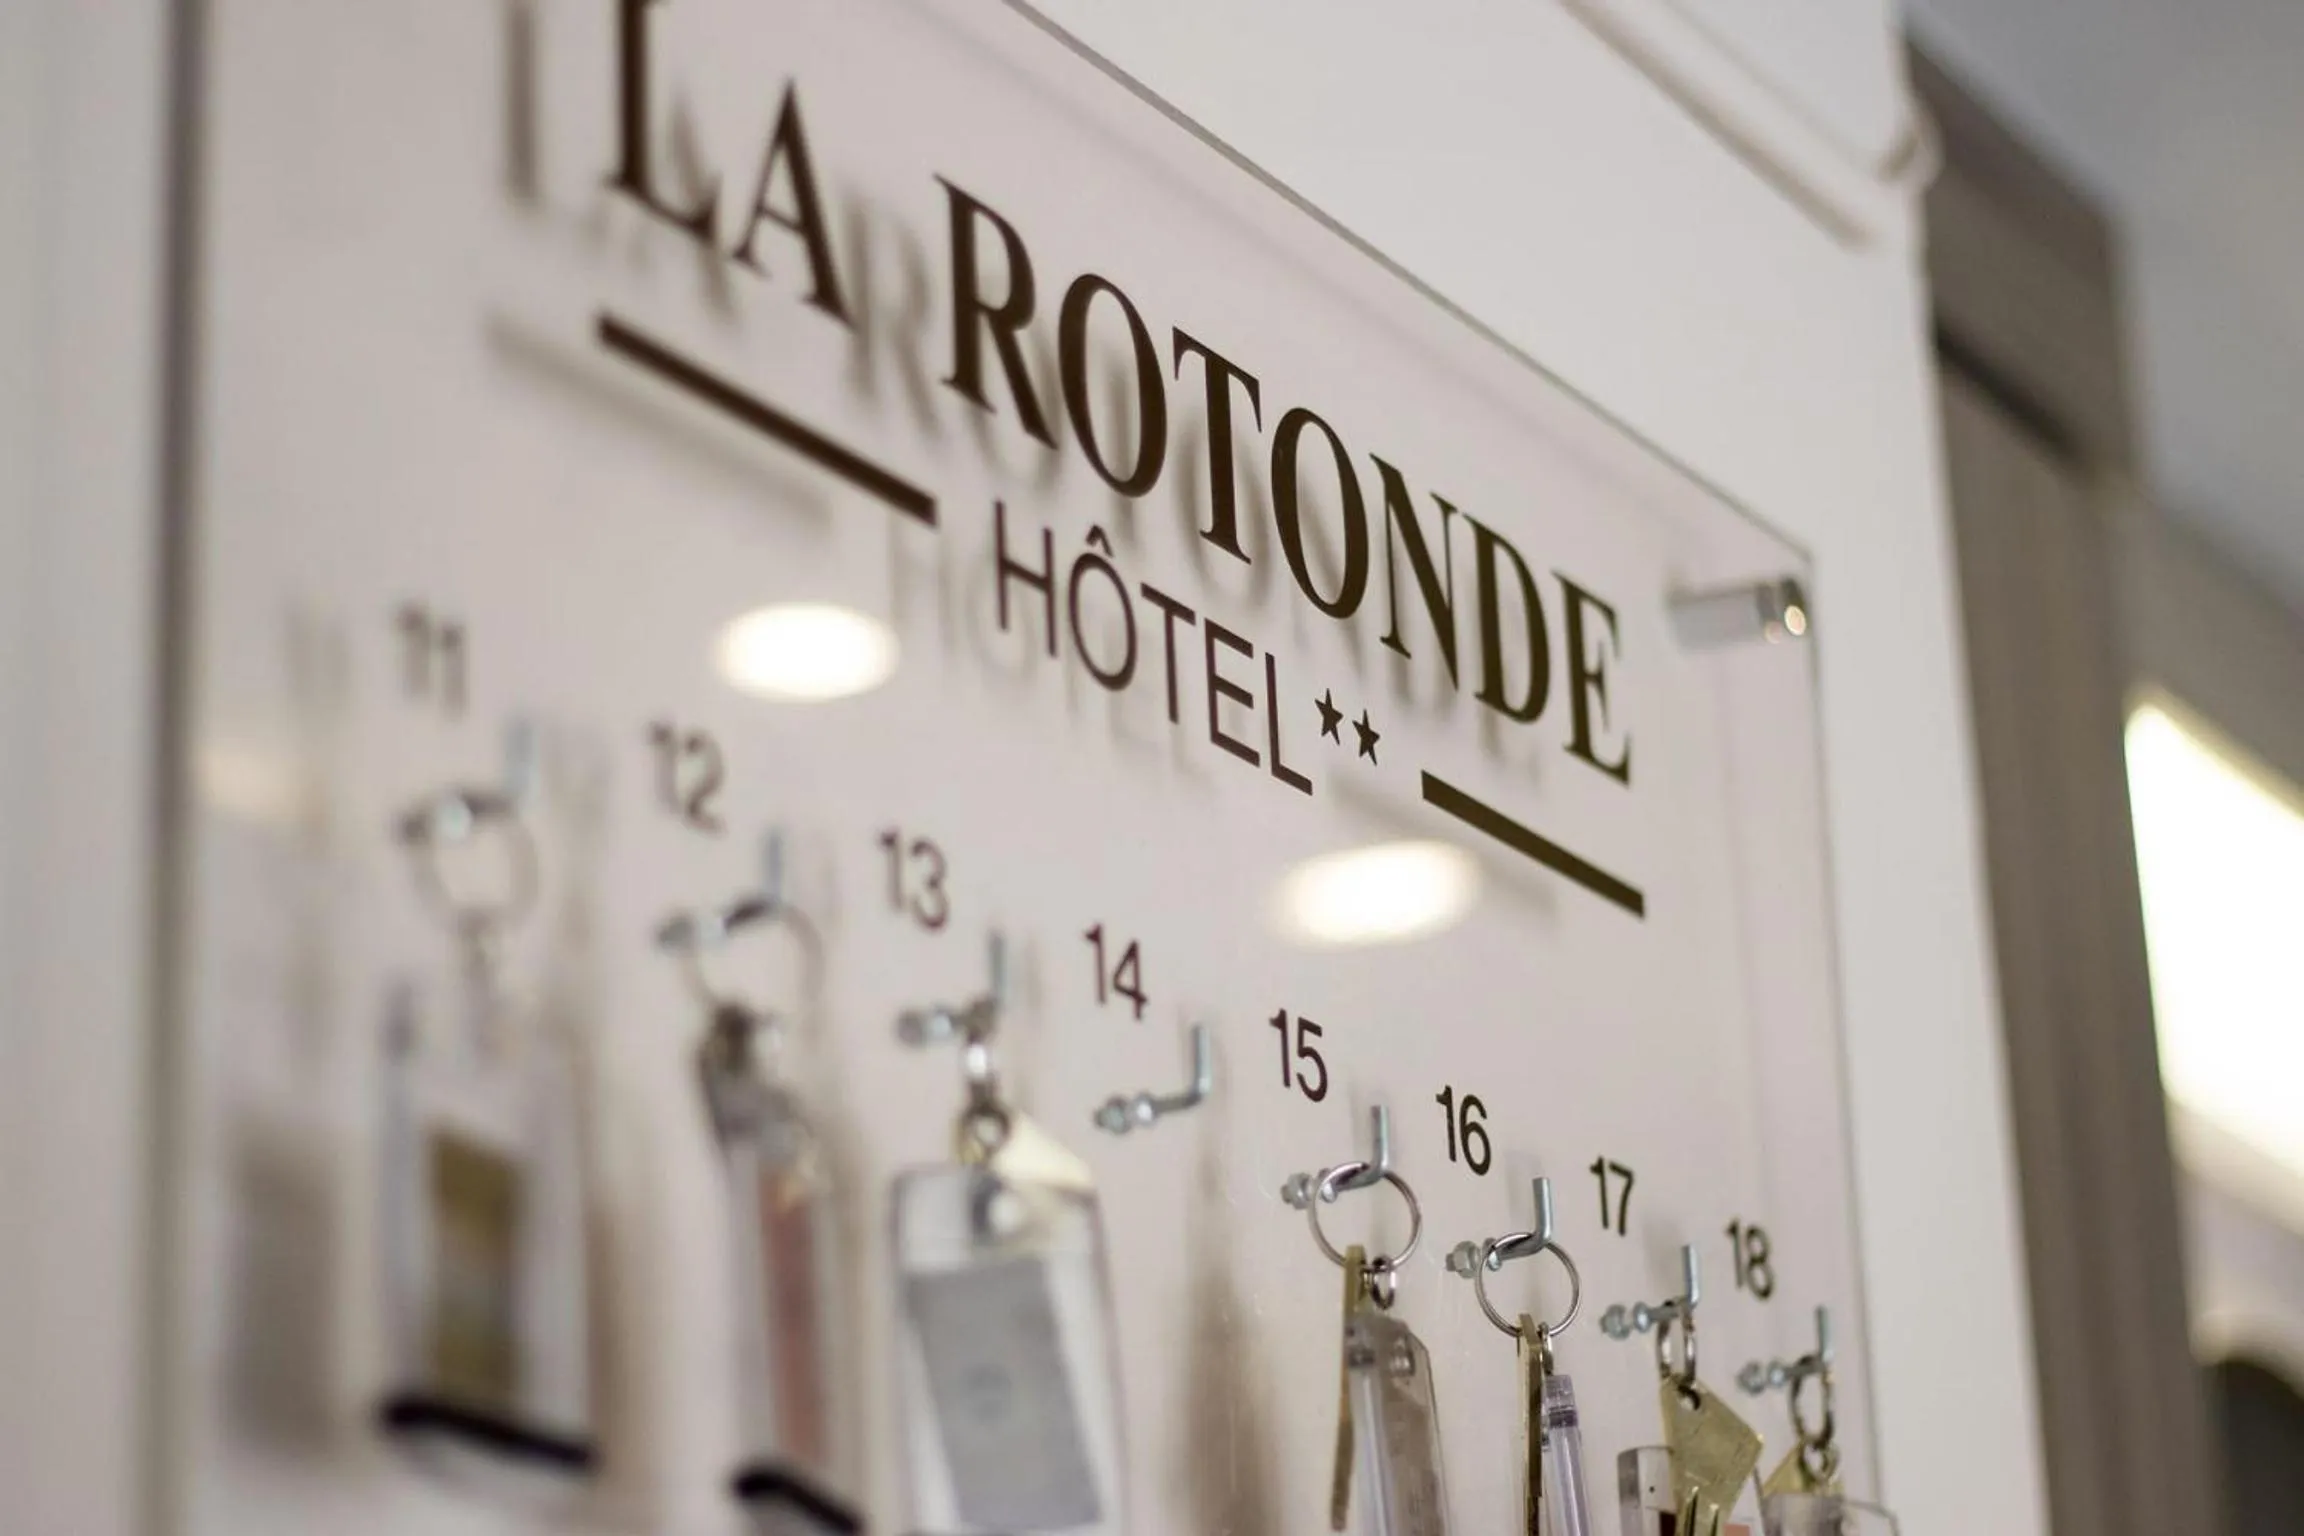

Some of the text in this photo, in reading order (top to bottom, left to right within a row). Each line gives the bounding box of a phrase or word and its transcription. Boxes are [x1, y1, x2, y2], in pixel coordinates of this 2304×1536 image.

[602, 0, 1631, 787] LA ROTONDE
[394, 602, 468, 714] 11
[995, 499, 1313, 797] HÔTEL
[650, 719, 726, 833] 12
[878, 828, 950, 932] 13
[1084, 922, 1148, 1020] 14
[1269, 1008, 1329, 1103] 15
[1435, 1085, 1492, 1176] 16
[1589, 1156, 1635, 1237] 17
[1726, 1218, 1775, 1301] 18
